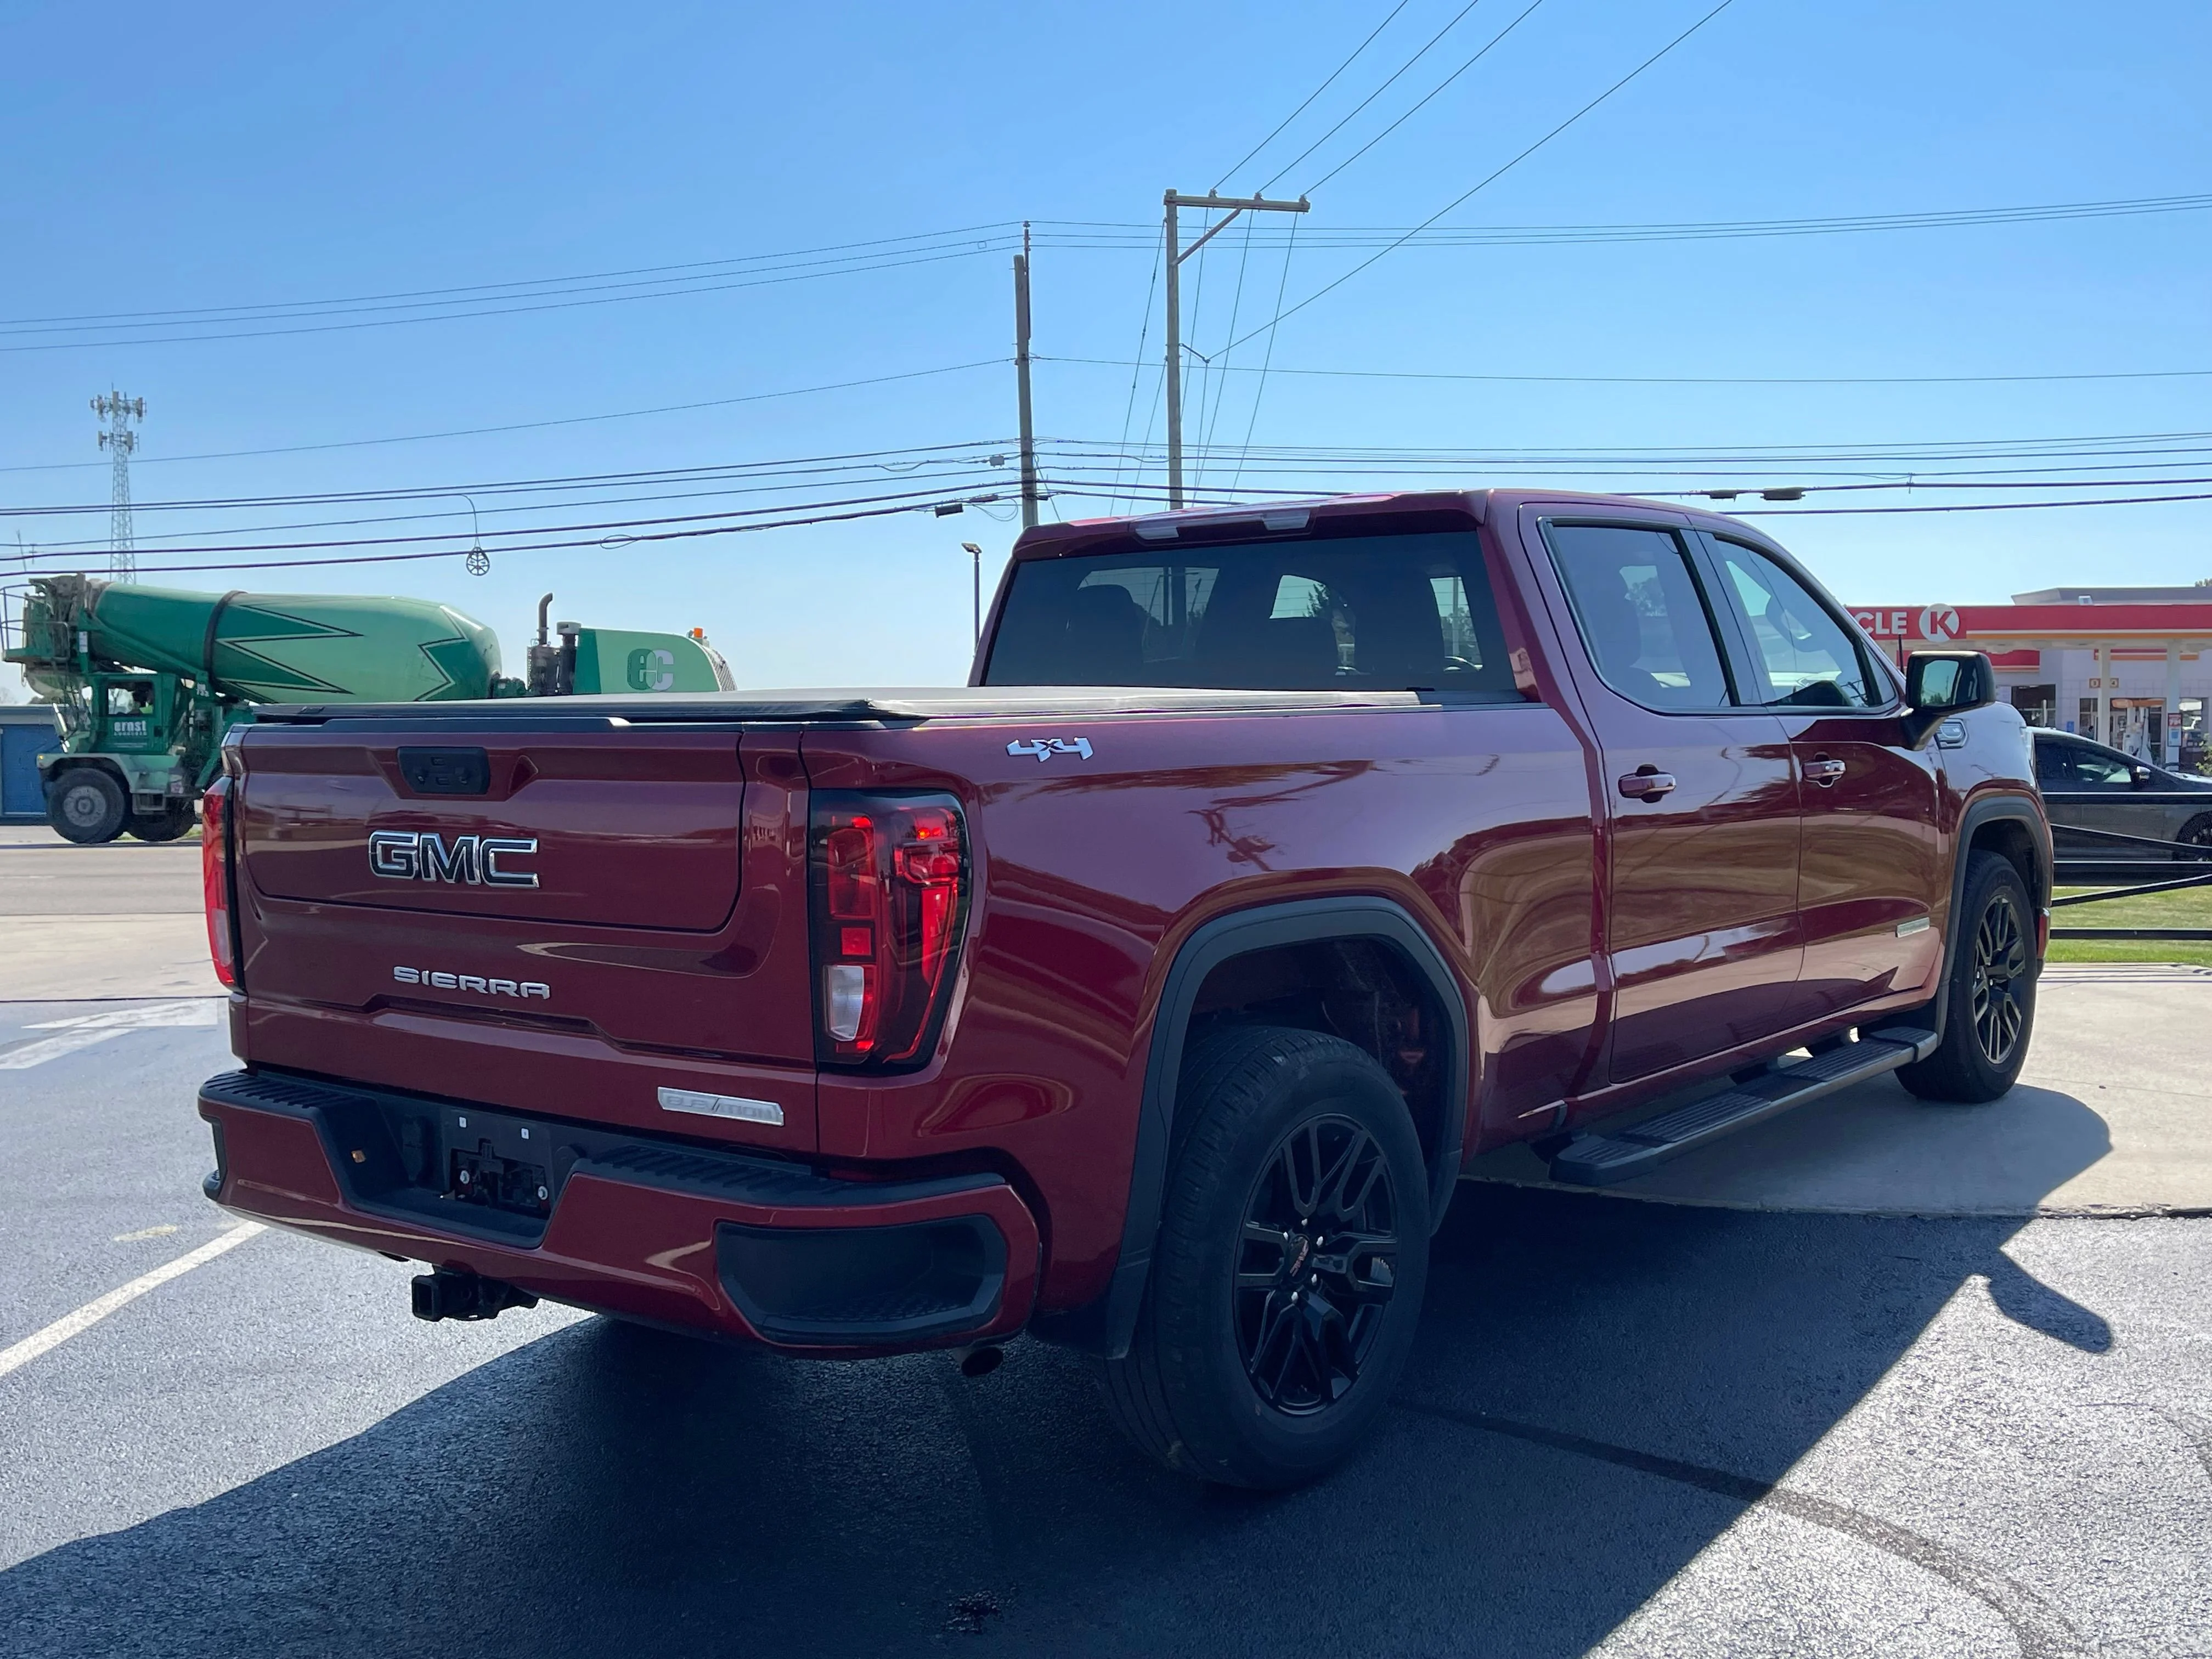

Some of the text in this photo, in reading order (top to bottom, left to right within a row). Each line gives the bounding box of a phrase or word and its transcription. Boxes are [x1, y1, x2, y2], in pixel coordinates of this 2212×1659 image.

[1930, 611, 1957, 639] K
[114, 720, 147, 731] ernst
[369, 830, 540, 889] GMC
[393, 966, 551, 1000] SIERRA
